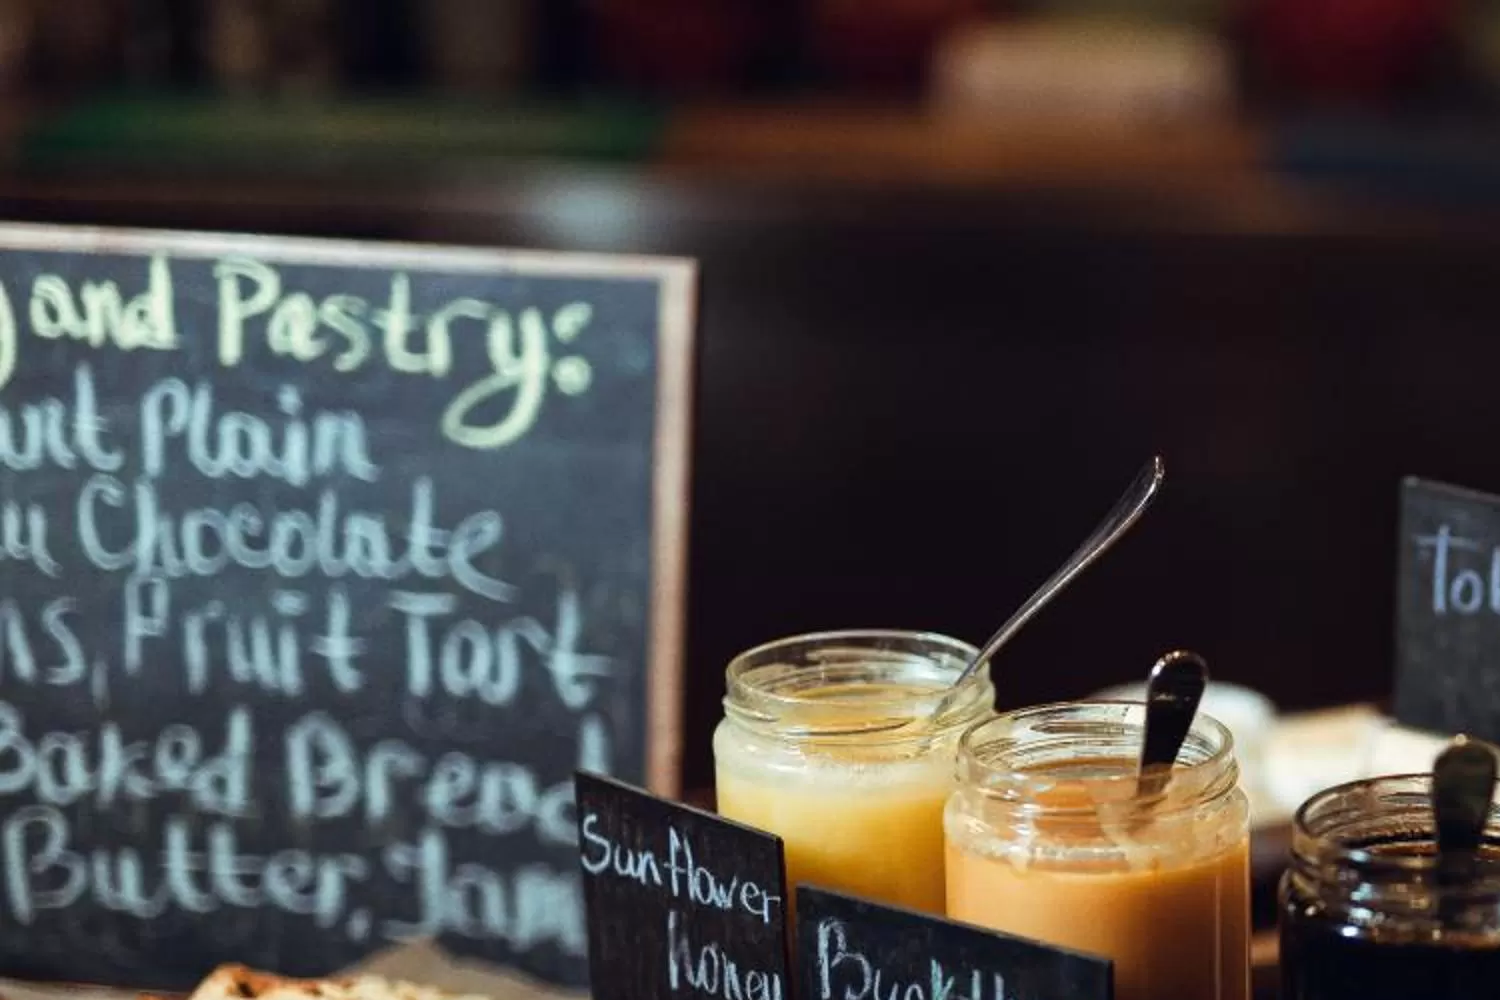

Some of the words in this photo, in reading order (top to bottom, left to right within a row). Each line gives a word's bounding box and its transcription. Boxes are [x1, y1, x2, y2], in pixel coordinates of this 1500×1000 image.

[28, 252, 180, 352] and
[213, 254, 594, 450] Pastry:
[140, 376, 378, 488] Plain
[78, 472, 516, 602] Chocolate
[581, 813, 782, 924] Sunflower
